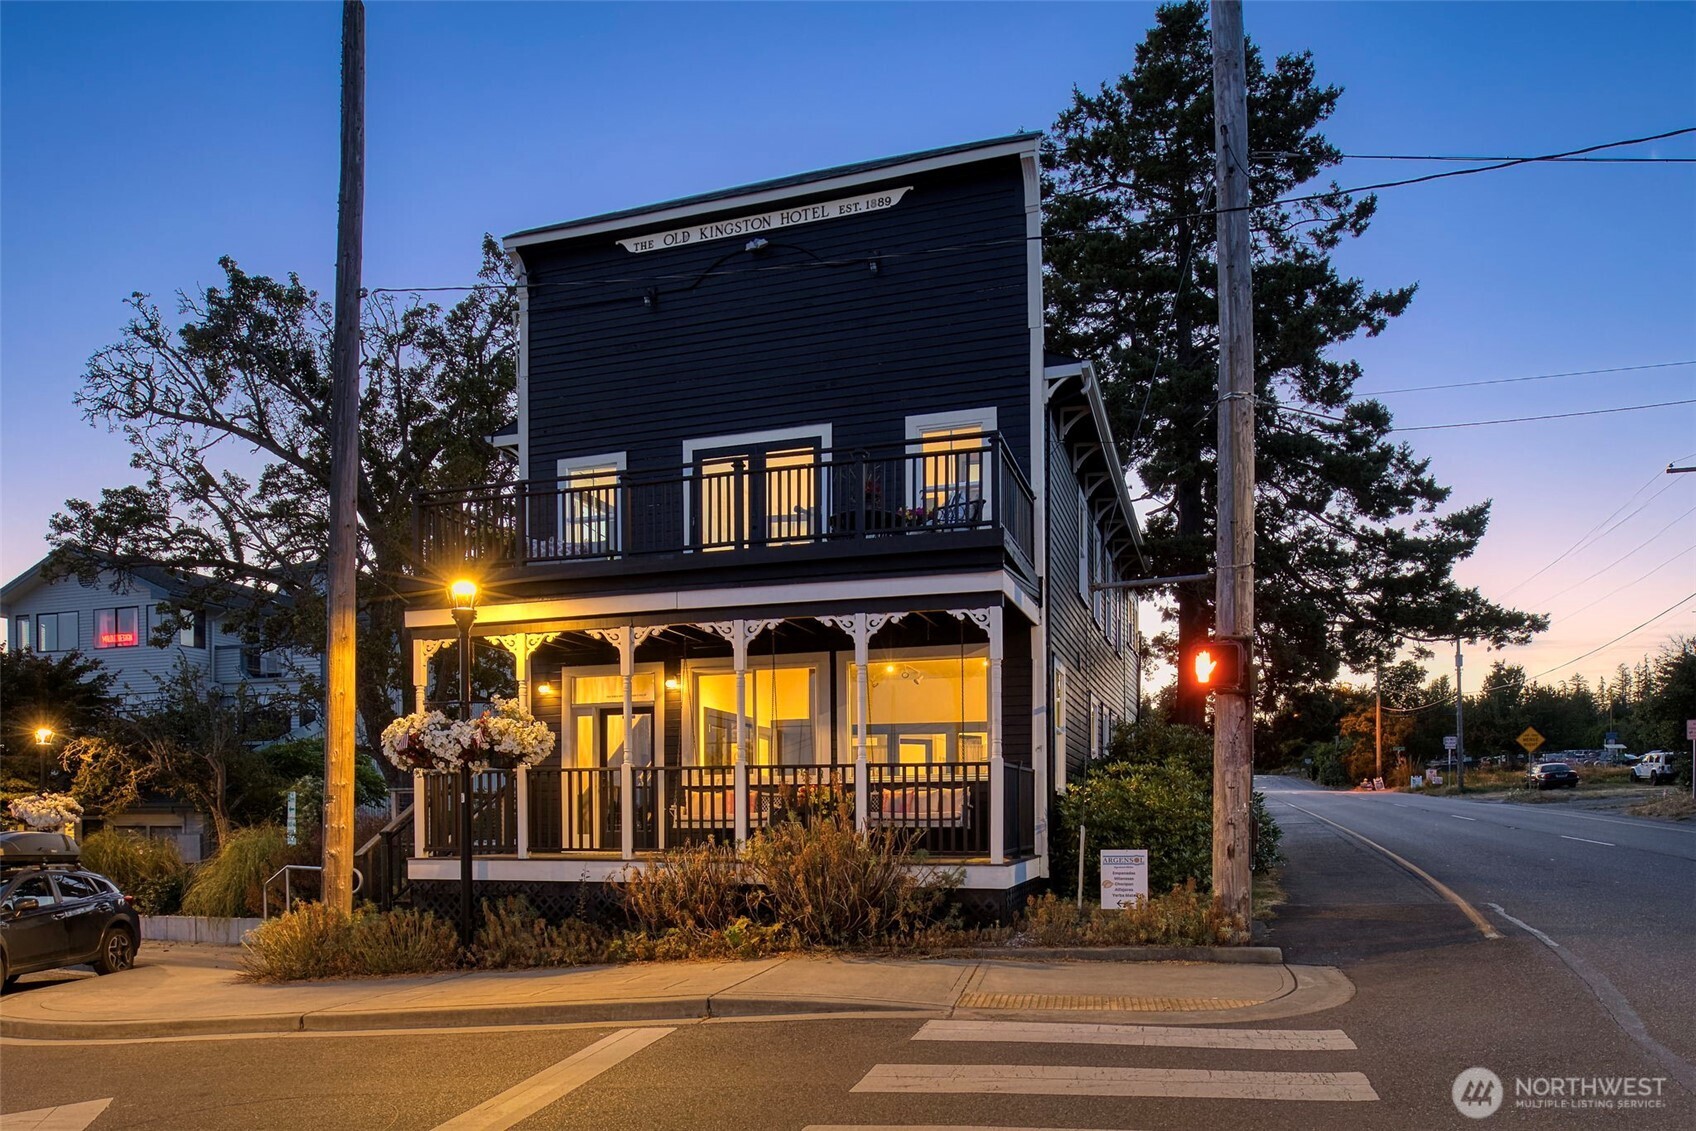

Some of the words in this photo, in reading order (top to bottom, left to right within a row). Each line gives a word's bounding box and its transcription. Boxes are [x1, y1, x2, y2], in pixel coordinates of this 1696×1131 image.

[633, 240, 654, 251] THE
[663, 231, 690, 245] OLD
[699, 215, 772, 240] KINGSTON
[780, 205, 830, 226] HOTEL
[839, 202, 862, 214] EST.
[865, 196, 891, 209] 1889
